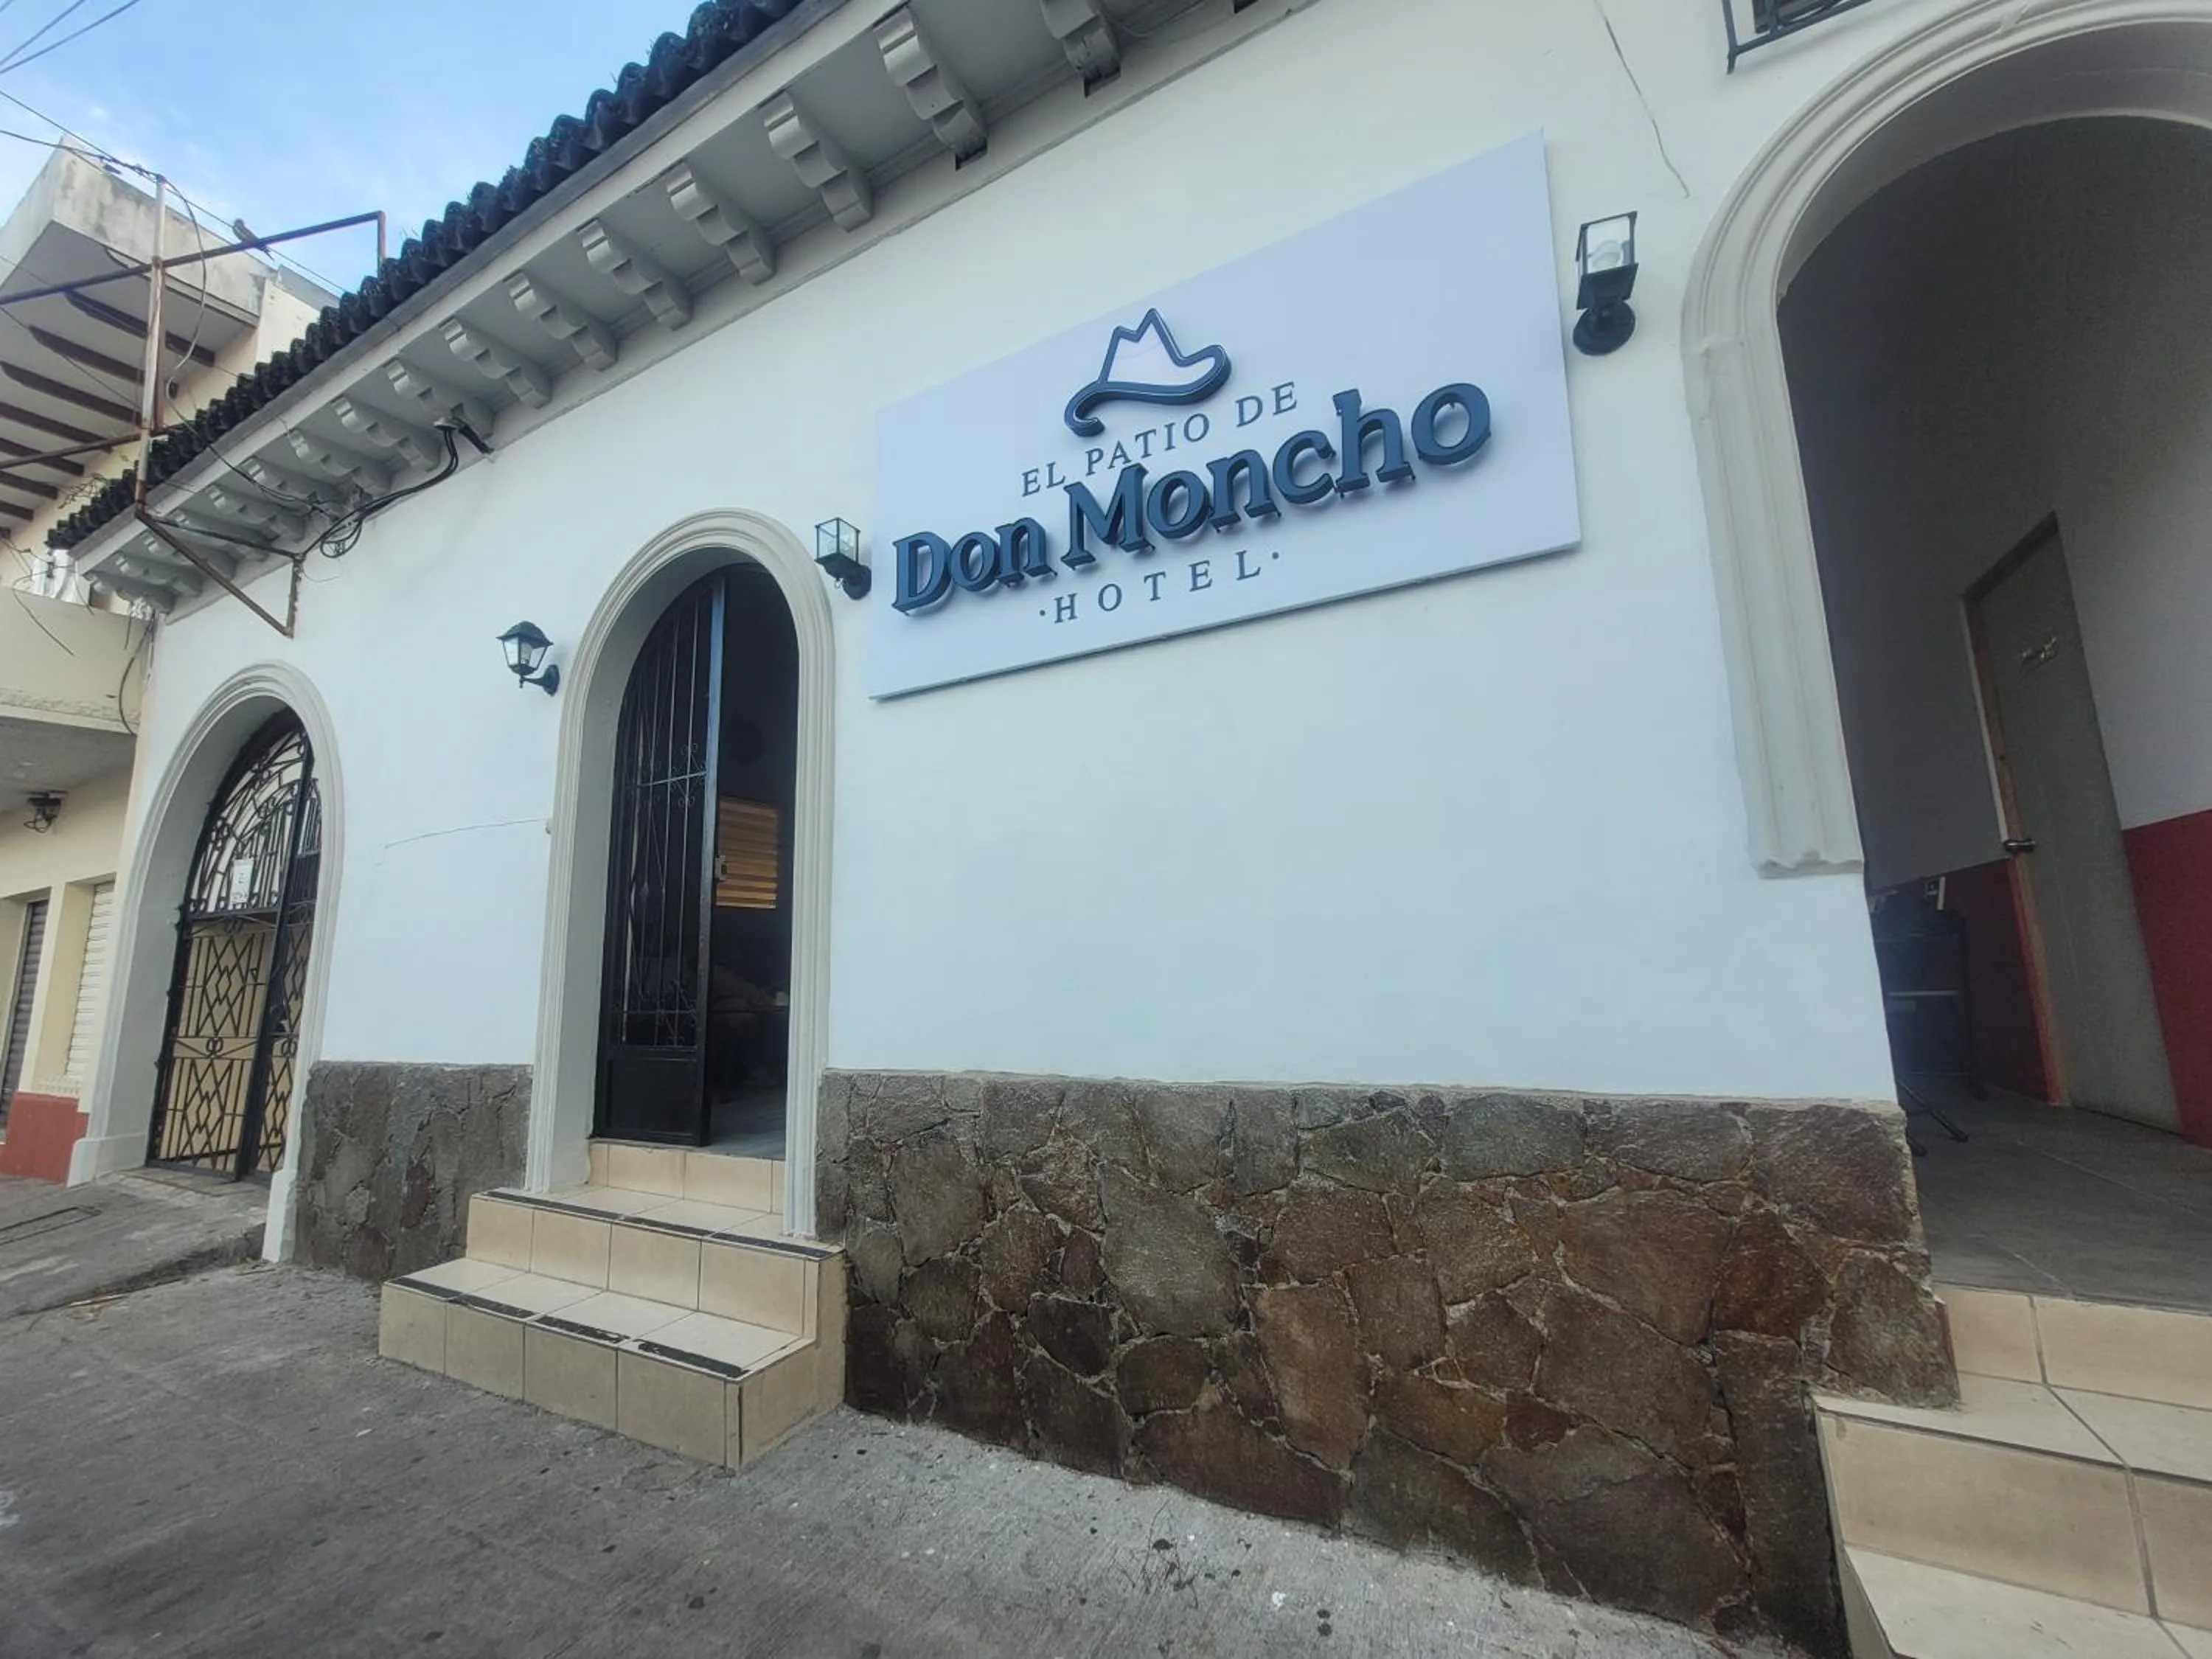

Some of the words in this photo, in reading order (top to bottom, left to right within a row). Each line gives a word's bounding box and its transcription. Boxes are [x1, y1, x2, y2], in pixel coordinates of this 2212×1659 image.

[892, 518, 1057, 614] Don
[1062, 383, 1491, 569] Moncho
[1022, 462, 1066, 497] EL
[1085, 414, 1210, 476] PATIO
[1236, 382, 1298, 428] DE
